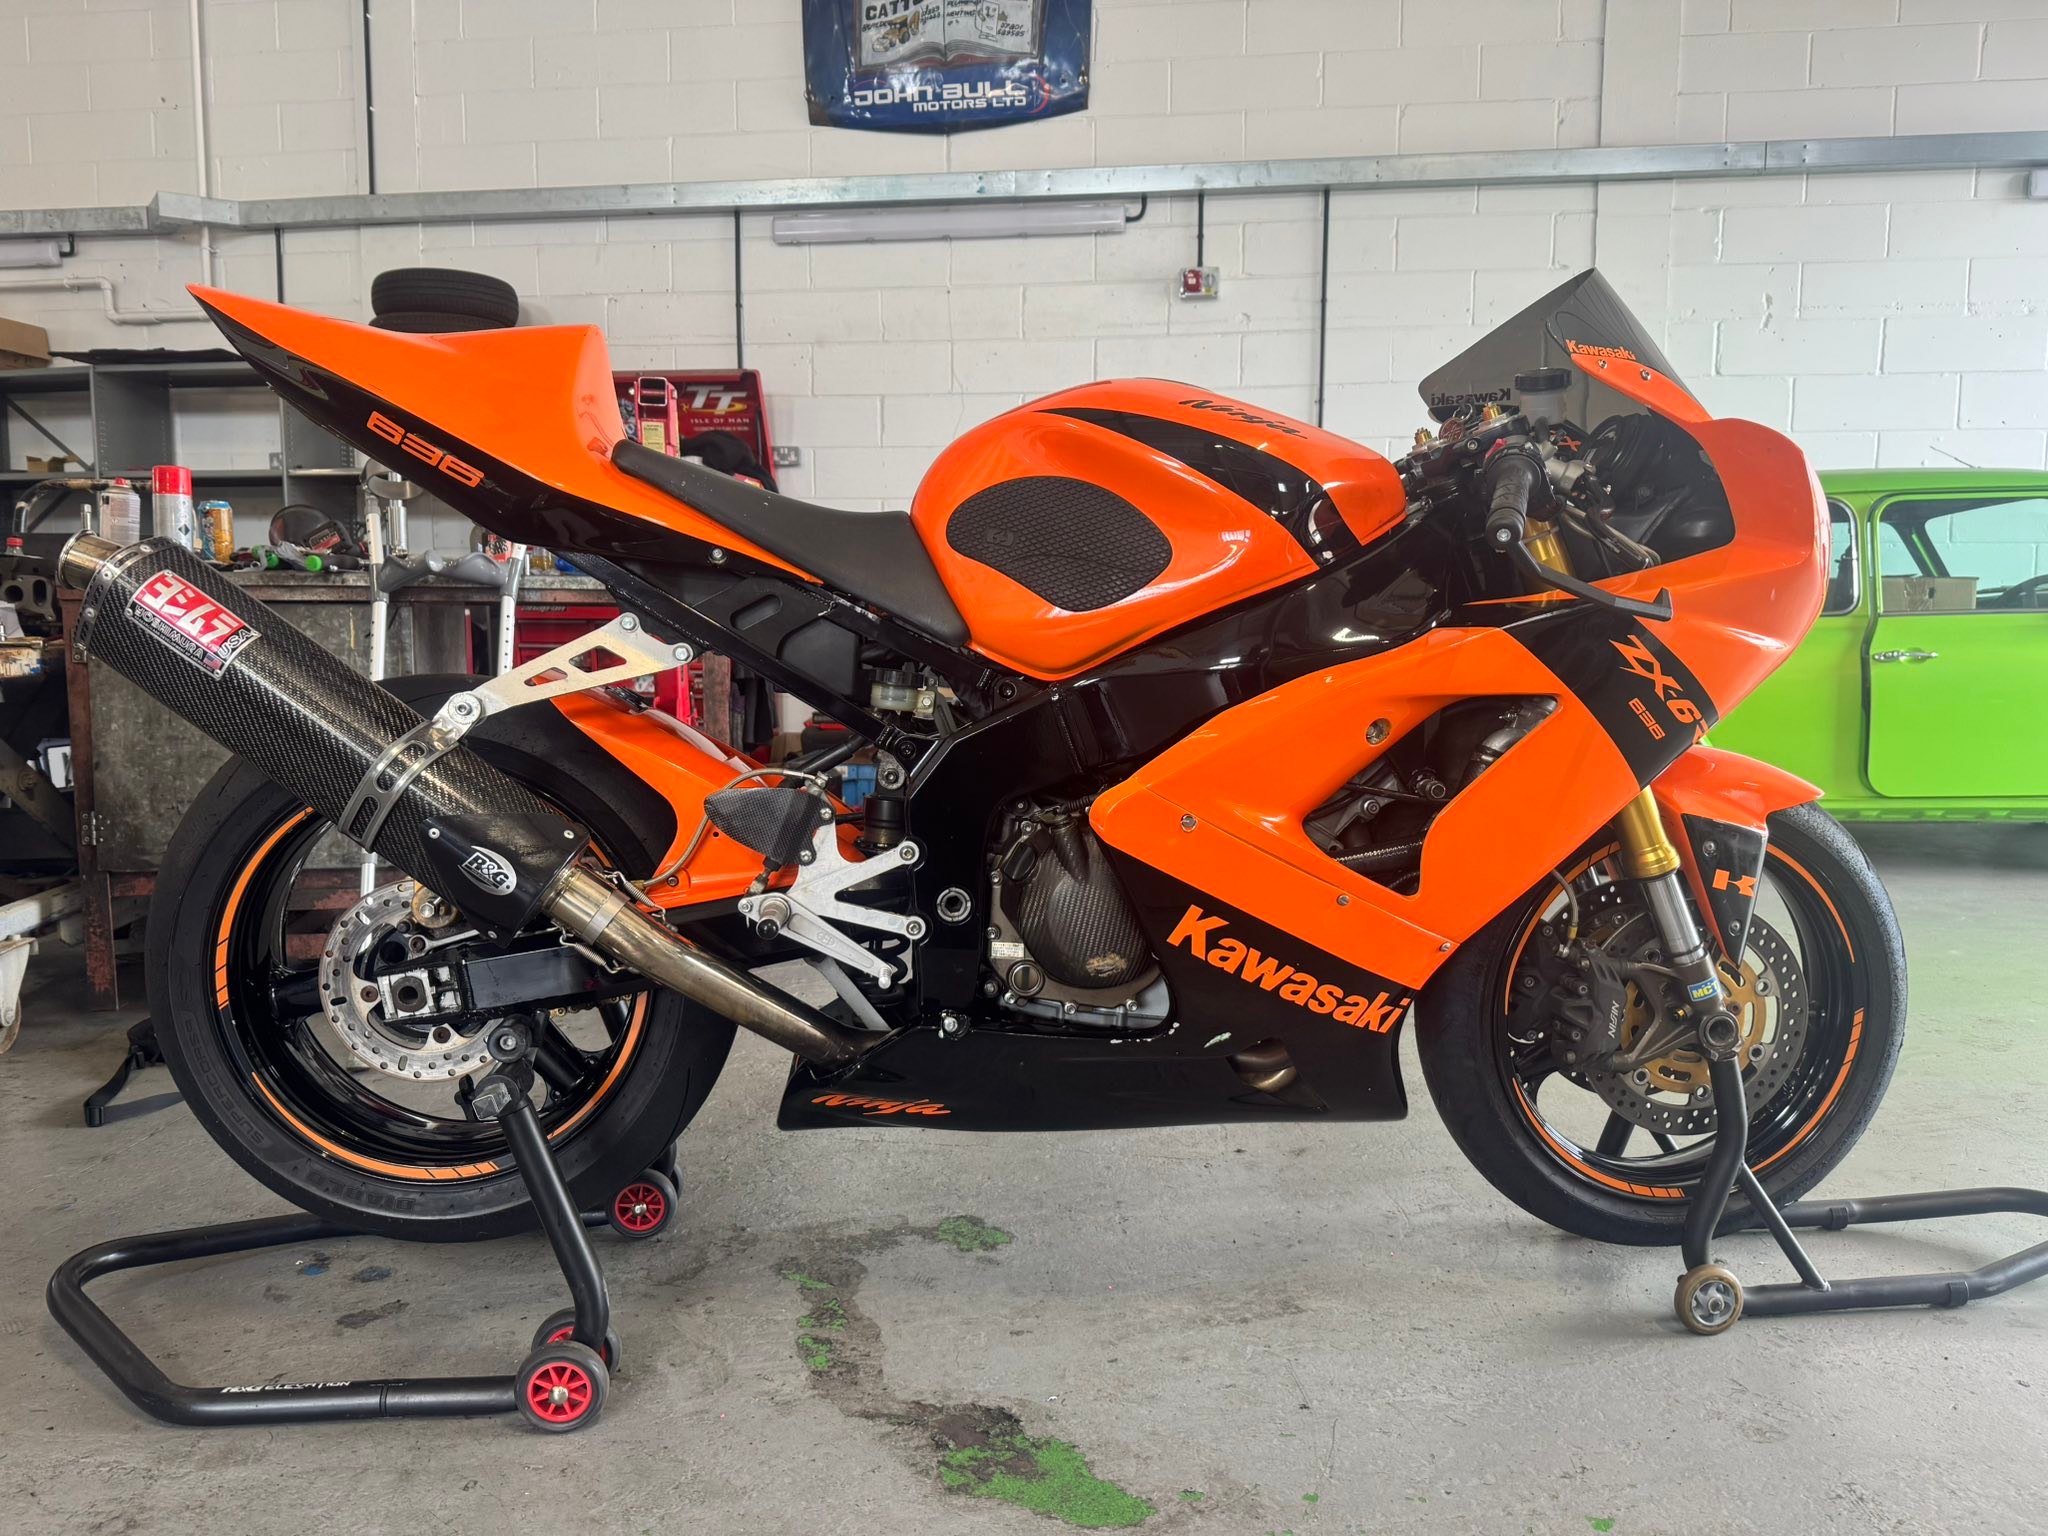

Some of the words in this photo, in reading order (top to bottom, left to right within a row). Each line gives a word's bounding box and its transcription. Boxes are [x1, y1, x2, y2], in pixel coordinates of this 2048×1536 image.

[854, 87, 933, 106] JOHN
[942, 79, 1027, 99] BULL
[913, 97, 989, 112] MOTORS
[992, 96, 1027, 107] LTD
[1565, 338, 1636, 361] Kawasaki
[686, 385, 747, 415] TT
[1179, 400, 1307, 439] Ninja
[367, 410, 485, 488] 636
[142, 575, 239, 644] ヨシムラ
[135, 605, 204, 659] YOSHIMURA
[217, 628, 250, 659] USA
[1628, 698, 1666, 740] 636
[468, 854, 510, 887] R&G
[1166, 904, 1412, 1034] Kawasaki
[1608, 1000, 1620, 1039] NISSIN
[811, 1095, 952, 1115] Ninja
